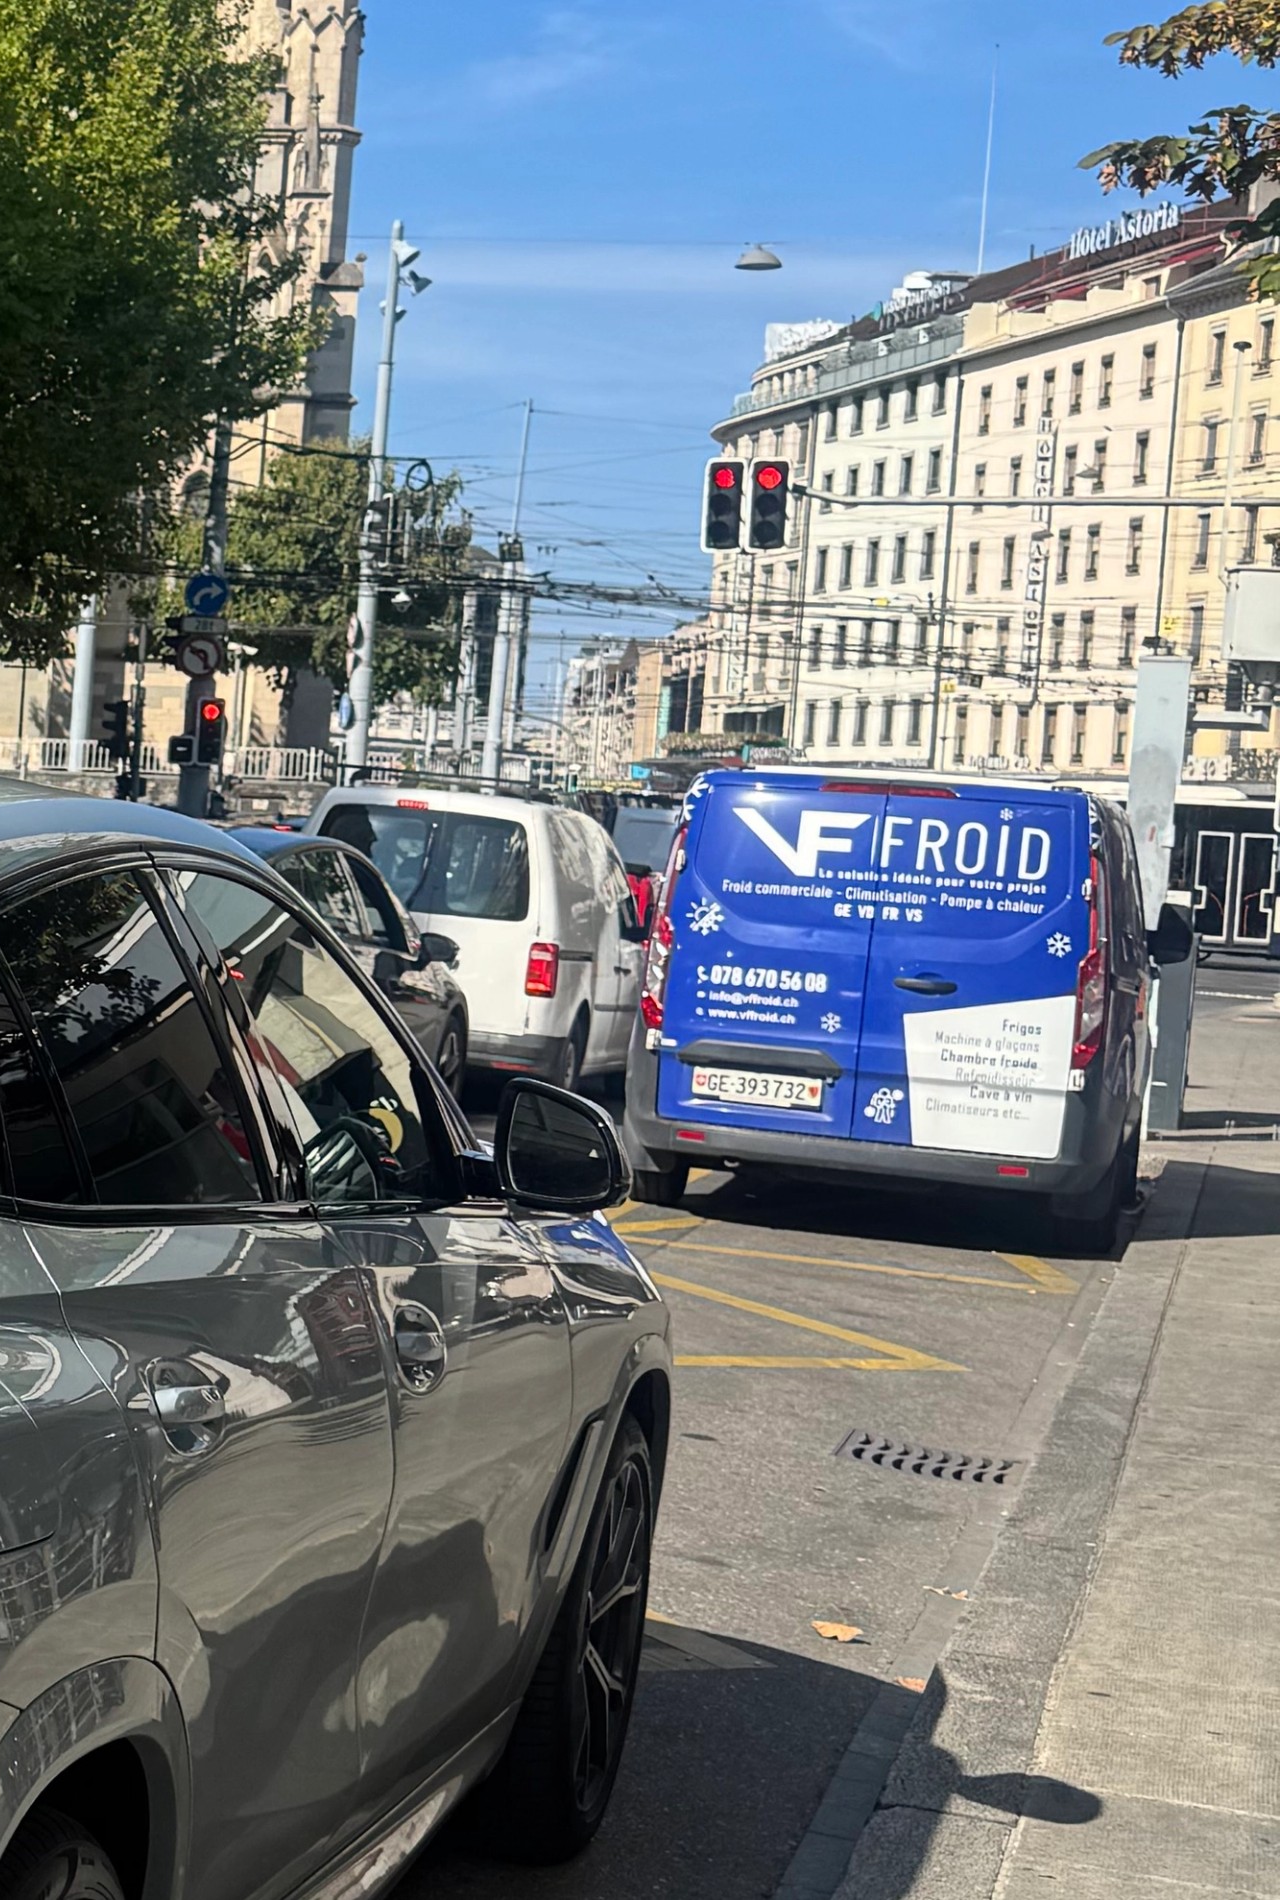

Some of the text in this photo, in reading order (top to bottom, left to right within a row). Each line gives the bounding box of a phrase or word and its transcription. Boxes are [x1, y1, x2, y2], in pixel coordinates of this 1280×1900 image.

[1114, 201, 1178, 246] Astoria
[732, 807, 1051, 881] VF FROID
[722, 878, 753, 894] Froid
[755, 883, 834, 898] commerciale
[939, 893, 983, 911] Pompe
[997, 899, 1045, 914] chaleur
[834, 903, 852, 918] GE
[881, 906, 900, 921] FR
[905, 908, 923, 922] VS
[710, 965, 828, 993] 078 670 56 08
[1002, 1019, 1042, 1036] Frigos
[935, 1031, 982, 1047] Machine
[995, 1037, 1040, 1054] glaçons
[940, 1048, 997, 1067] Chambre
[970, 1085, 1000, 1101] Cave
[1015, 1091, 1033, 1103] vin
[925, 1098, 999, 1118] Climatiseurs
